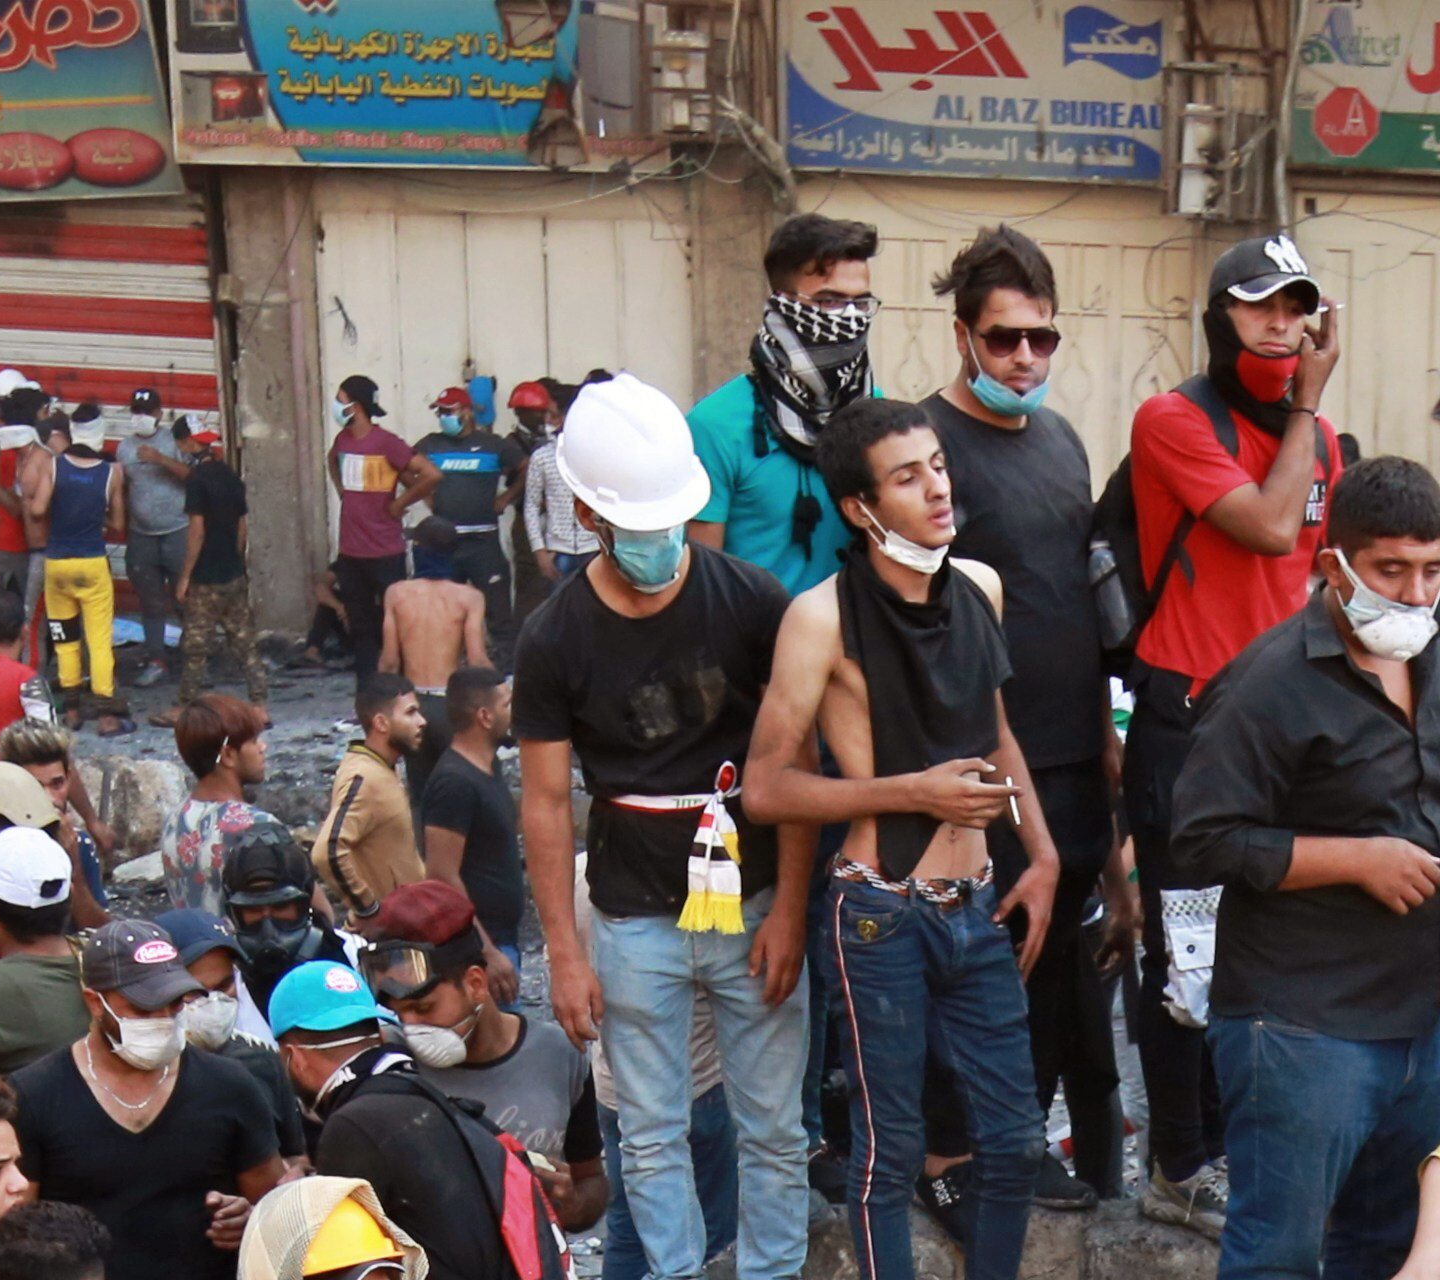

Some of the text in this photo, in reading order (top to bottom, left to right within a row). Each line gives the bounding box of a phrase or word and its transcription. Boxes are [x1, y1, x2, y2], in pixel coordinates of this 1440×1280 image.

[805, 6, 1029, 92] الباز
[1069, 24, 1159, 59] مكتب
[933, 94, 971, 121] AL
[980, 96, 1038, 124] BAZ
[440, 458, 481, 470] NIKE
